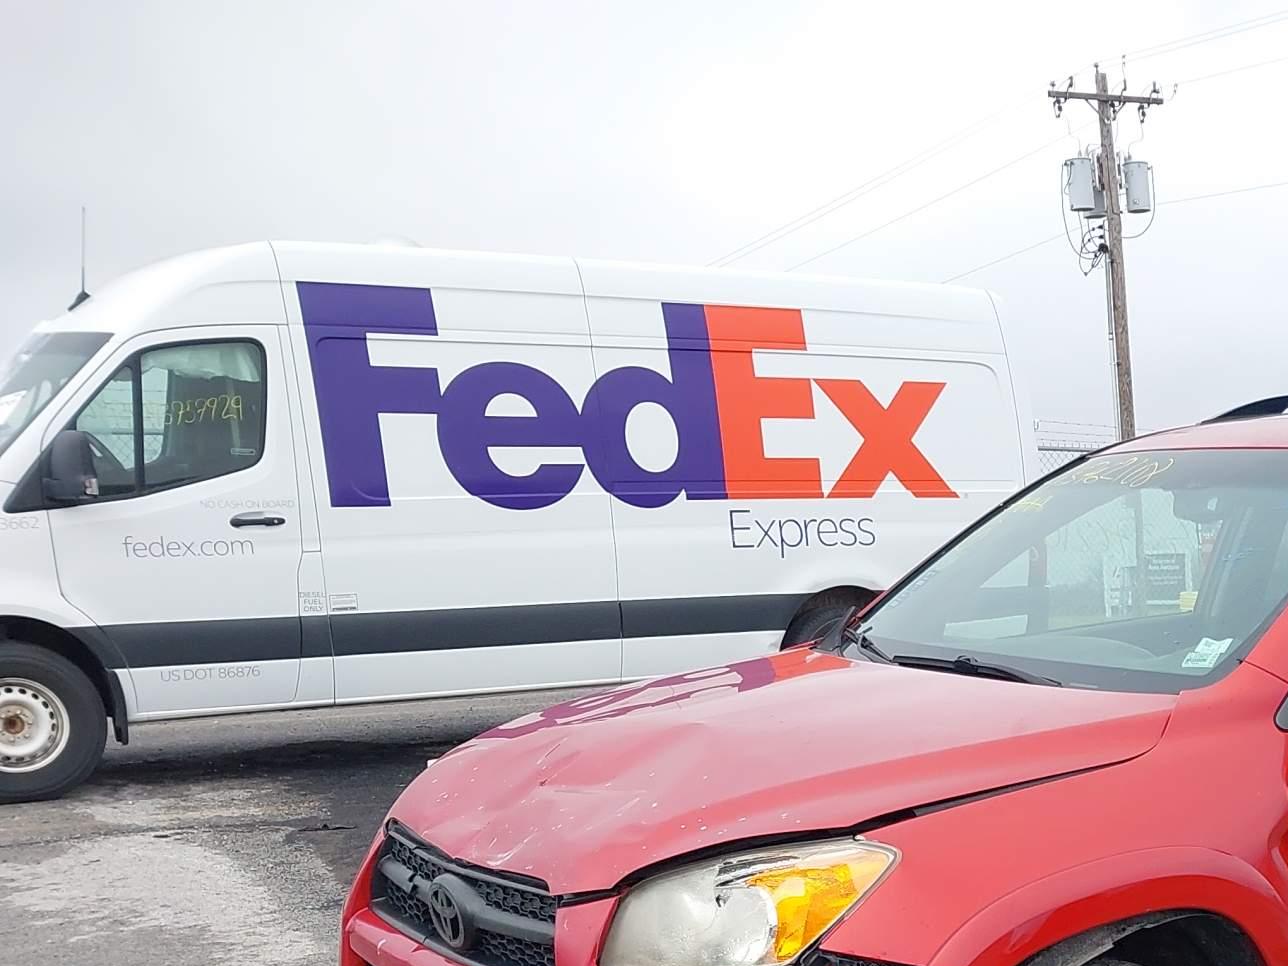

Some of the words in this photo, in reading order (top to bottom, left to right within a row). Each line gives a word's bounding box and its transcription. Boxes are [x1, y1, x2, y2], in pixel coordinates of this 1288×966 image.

[295, 280, 961, 510] FedEx
[217, 499, 244, 509] CASH
[245, 499, 260, 509] ON
[262, 499, 295, 508] BOARD
[729, 509, 876, 559] Express
[122, 535, 255, 558] fedex.com
[160, 669, 181, 682] US
[183, 667, 214, 681] DOT
[218, 665, 260, 679] 86876
